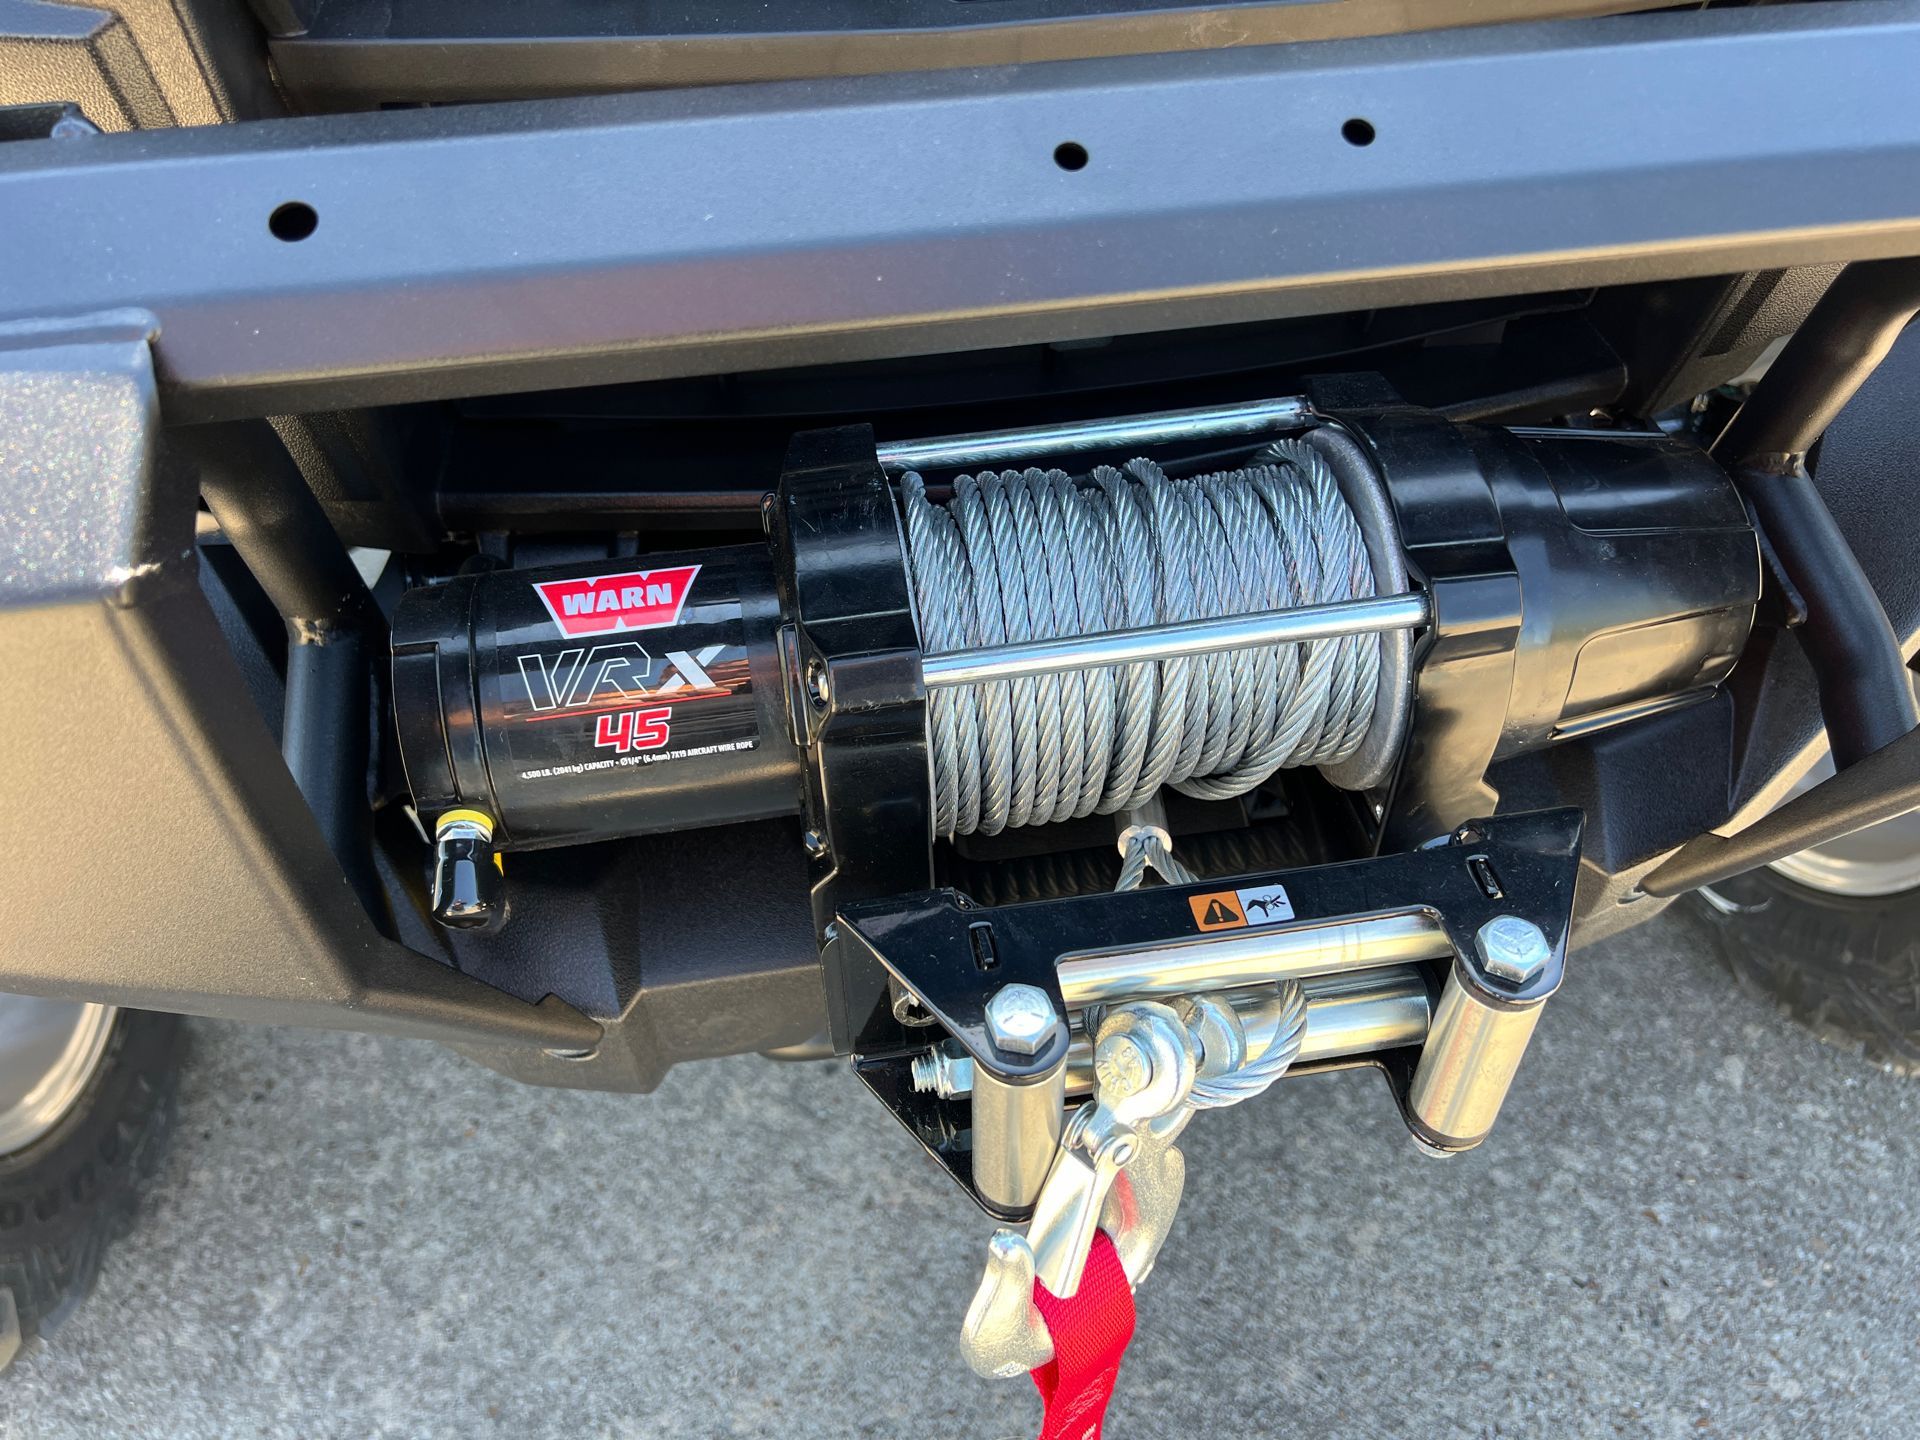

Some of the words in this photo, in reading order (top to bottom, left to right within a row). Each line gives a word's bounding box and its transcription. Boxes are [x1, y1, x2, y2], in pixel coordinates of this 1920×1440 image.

[562, 583, 672, 616] WARN
[517, 641, 727, 711] VRX
[594, 707, 672, 753] 45
[584, 760, 614, 771] CAPACITY
[643, 751, 671, 763] (6.4mm)
[687, 745, 718, 756] AIRCRAFT
[718, 743, 736, 752] WIRE
[736, 741, 753, 750] ROPE
